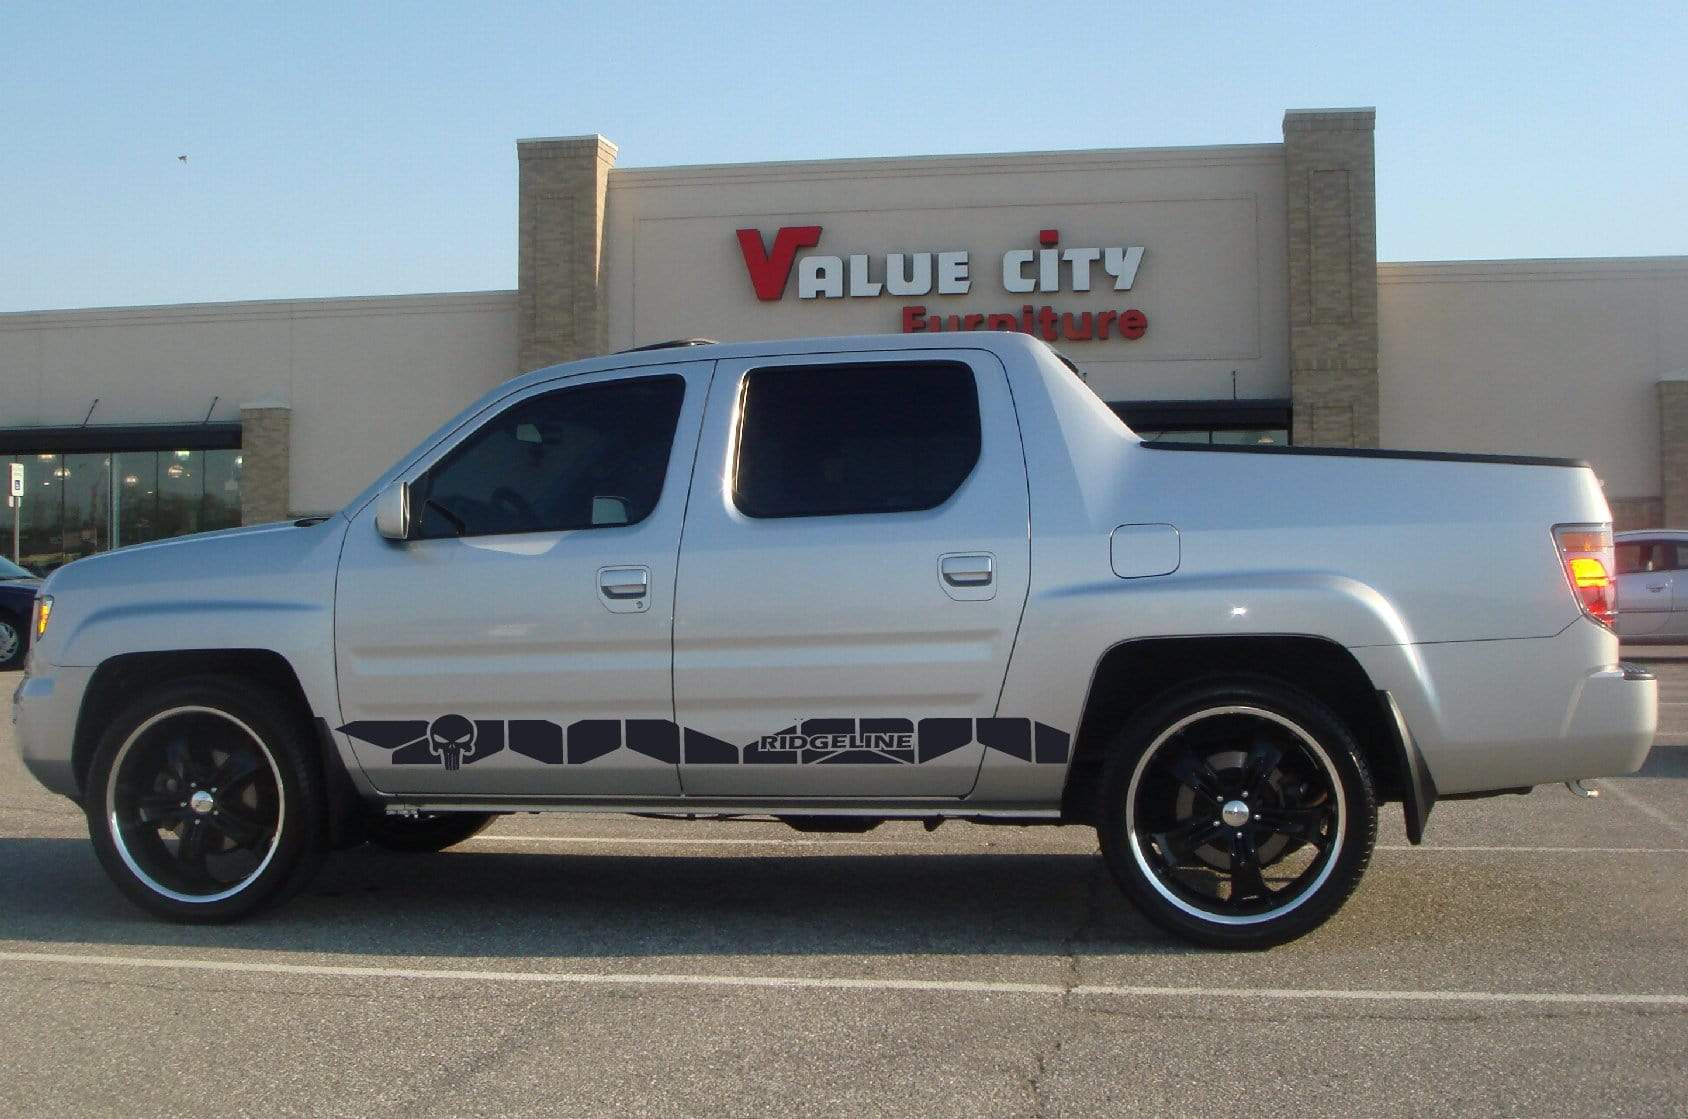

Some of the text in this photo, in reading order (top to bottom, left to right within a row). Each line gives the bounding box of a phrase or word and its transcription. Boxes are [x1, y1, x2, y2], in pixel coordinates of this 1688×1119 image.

[736, 226, 972, 301] VALUE
[902, 304, 1148, 341] Furniture
[760, 734, 913, 750] RIDGELINE
